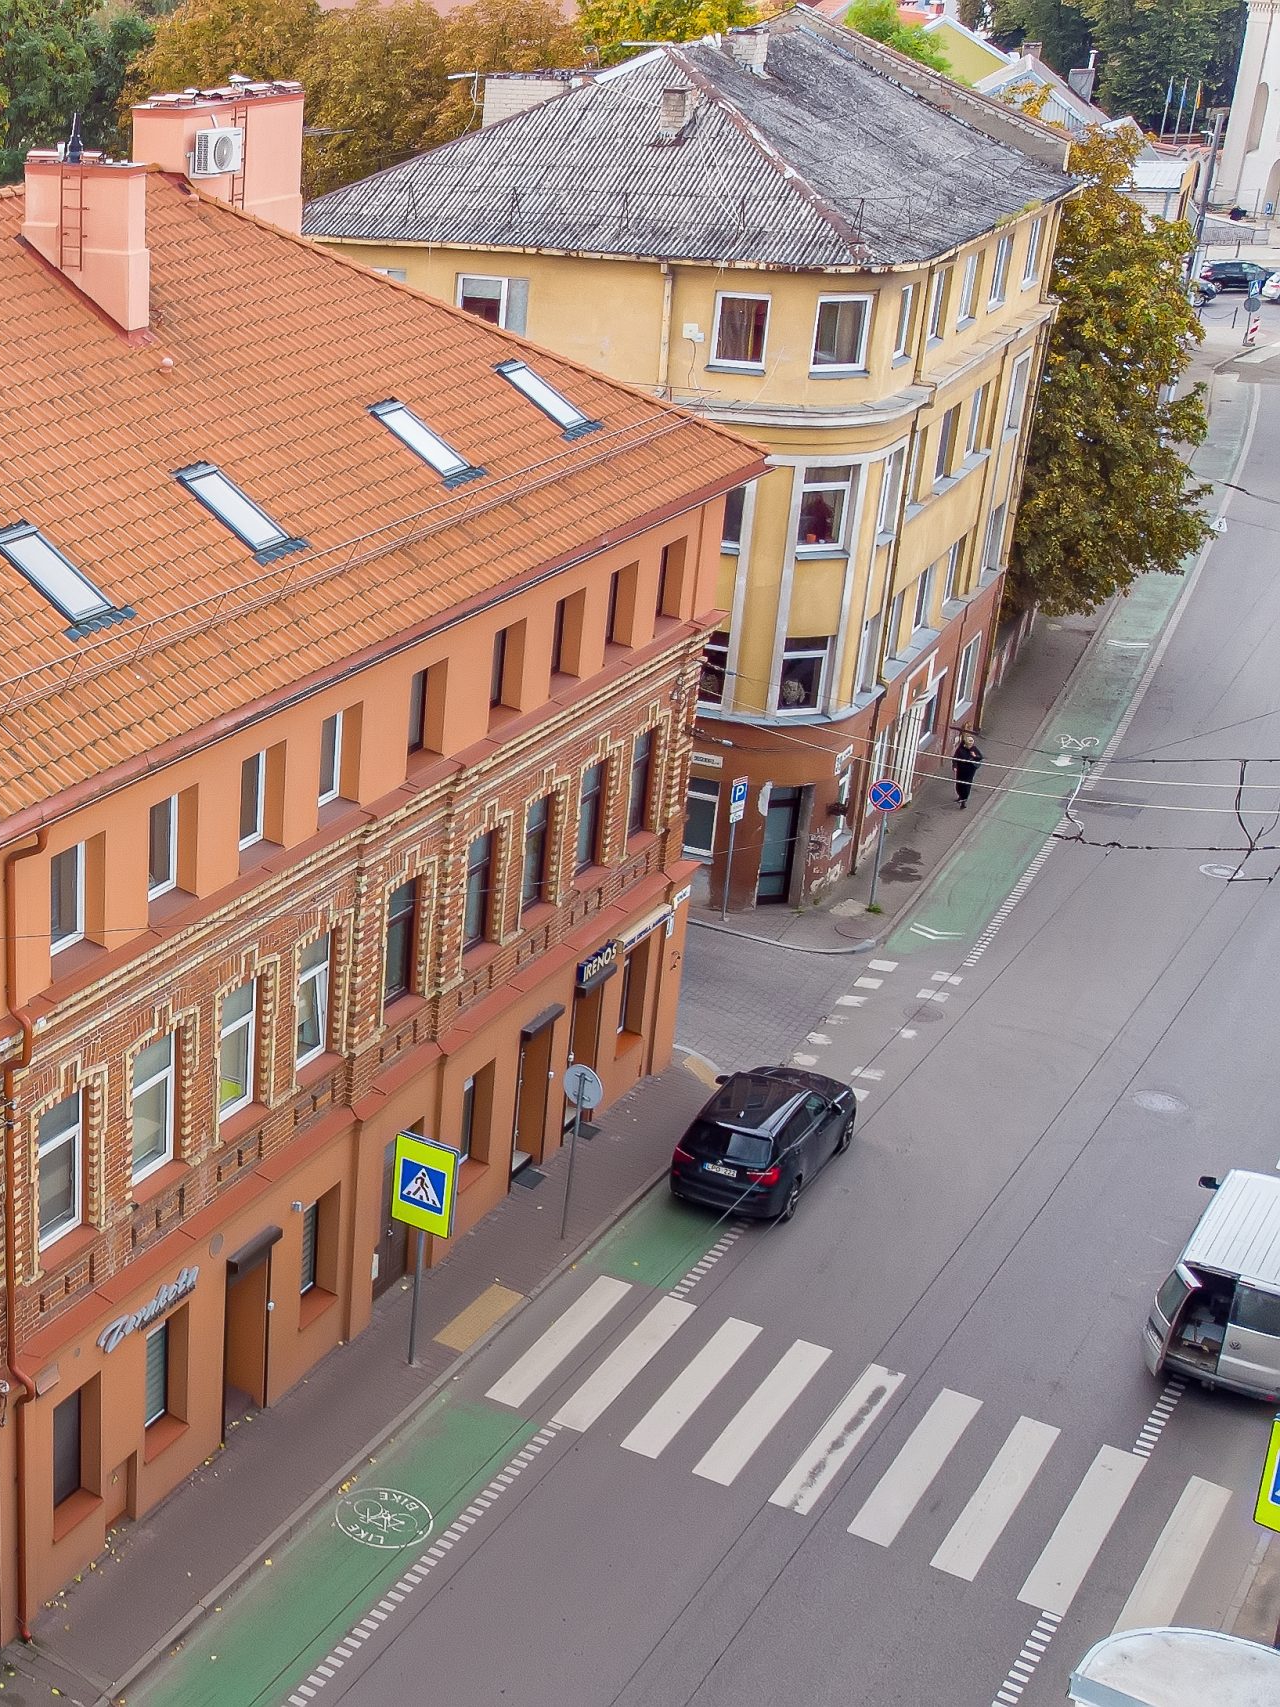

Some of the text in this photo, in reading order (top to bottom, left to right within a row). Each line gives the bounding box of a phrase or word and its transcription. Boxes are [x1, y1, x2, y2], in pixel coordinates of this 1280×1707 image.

[736, 785, 745, 801] P
[583, 943, 617, 983] IRENOS
[379, 1491, 420, 1511] BIKE
[346, 1523, 385, 1545] LIKE
